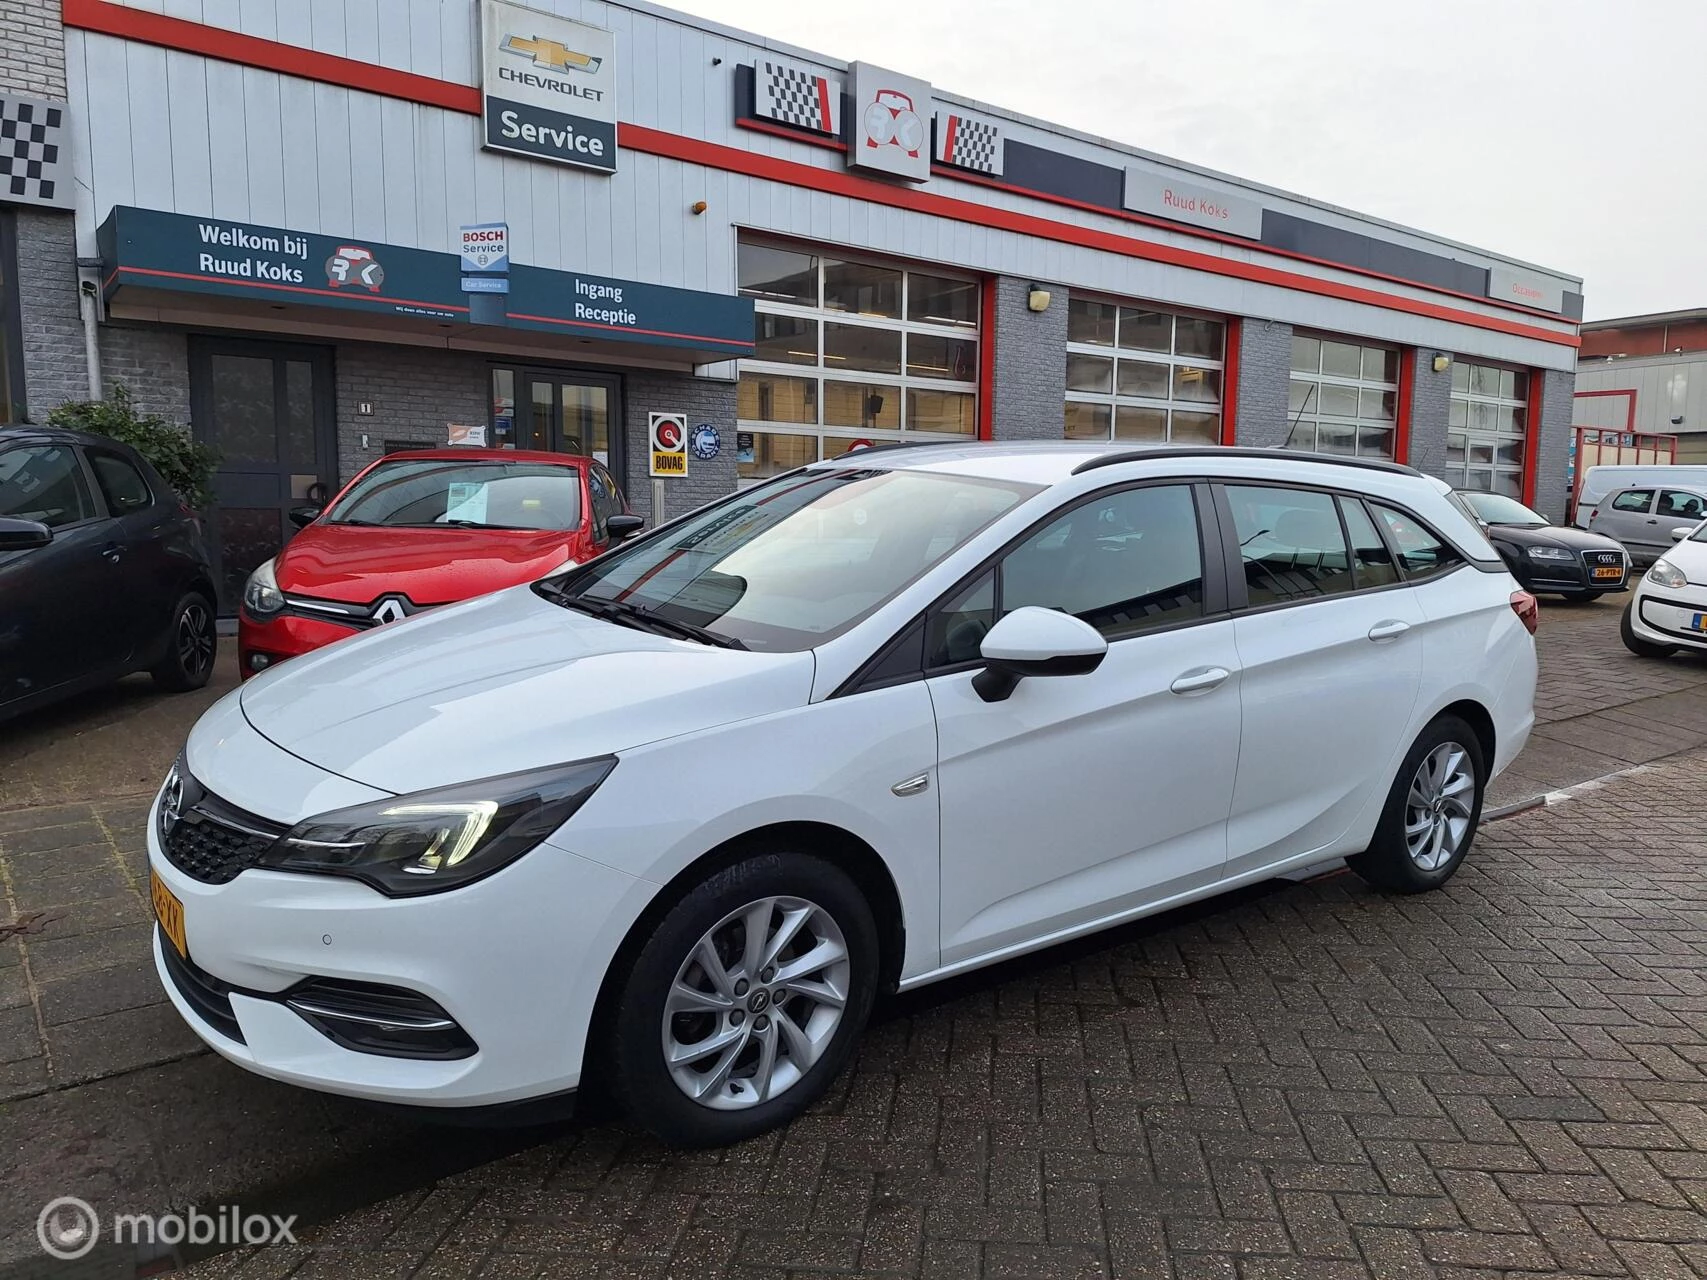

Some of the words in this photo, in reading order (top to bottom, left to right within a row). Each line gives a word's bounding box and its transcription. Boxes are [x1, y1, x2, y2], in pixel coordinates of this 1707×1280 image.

[498, 67, 604, 102] CHEVROLET
[500, 110, 604, 156] Service
[1164, 189, 1195, 211] Ruud
[1200, 199, 1229, 219] Koks
[199, 223, 280, 253] Welkom
[284, 235, 308, 260] bij
[463, 230, 504, 243] BOSCH
[463, 244, 504, 254] Service
[199, 252, 251, 277] Ruud
[256, 260, 304, 283] Koks
[479, 281, 502, 289] Service
[575, 278, 623, 303] Ingang
[575, 302, 636, 325] Receptie
[656, 455, 683, 470] BOVAG
